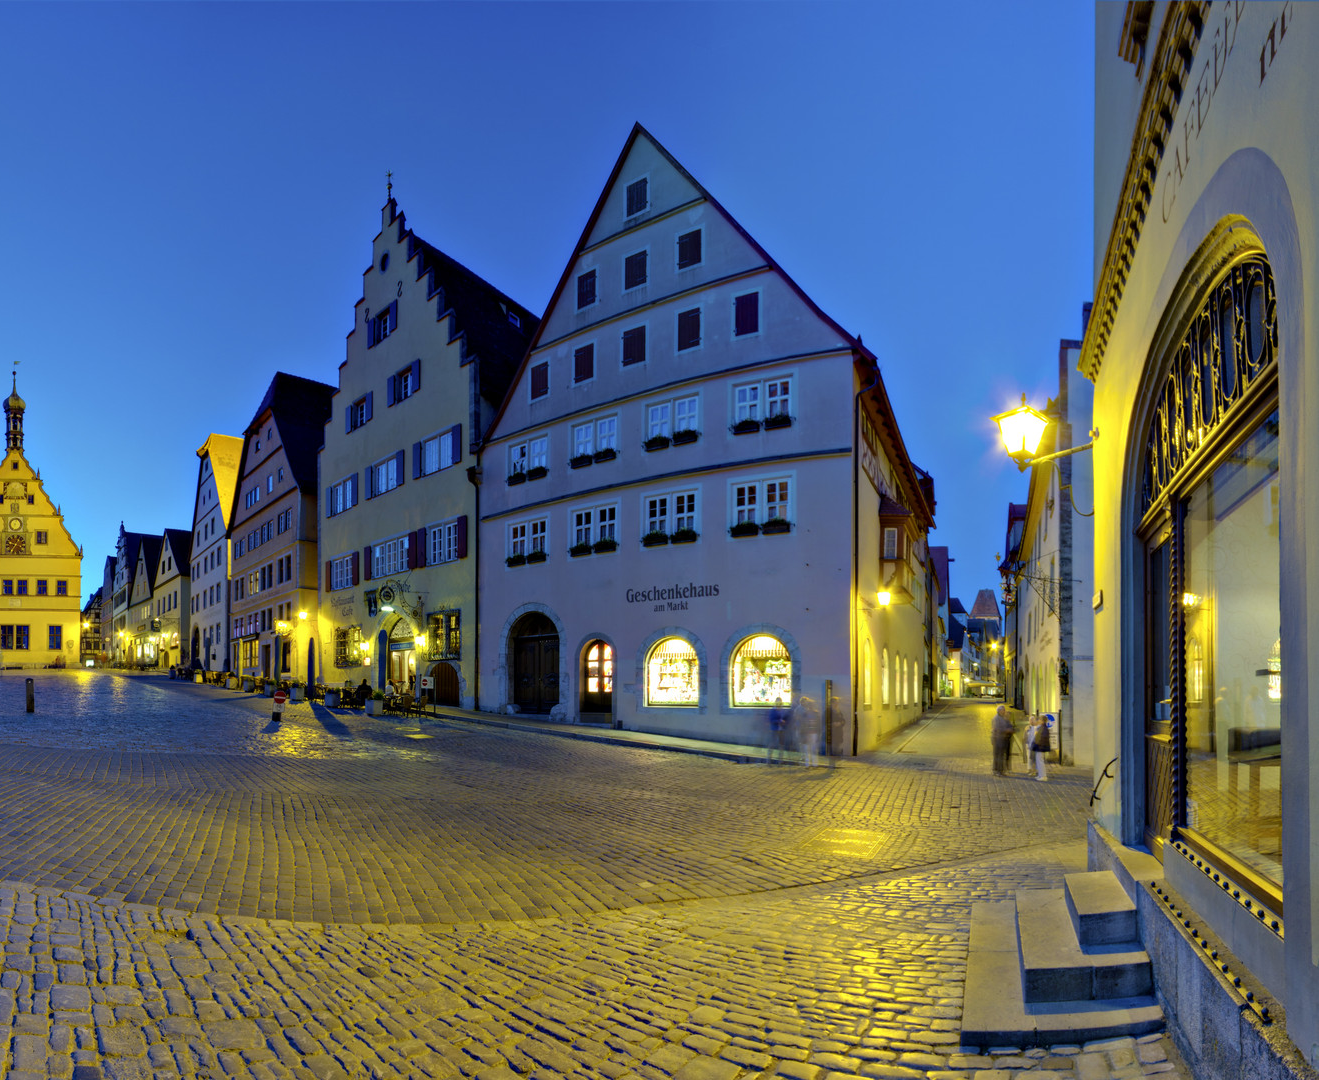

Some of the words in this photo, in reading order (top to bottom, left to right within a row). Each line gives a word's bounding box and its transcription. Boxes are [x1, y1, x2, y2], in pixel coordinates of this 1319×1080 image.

[626, 582, 720, 603] Geschenkehaus
[654, 604, 665, 612] am
[667, 601, 689, 612] Markt
